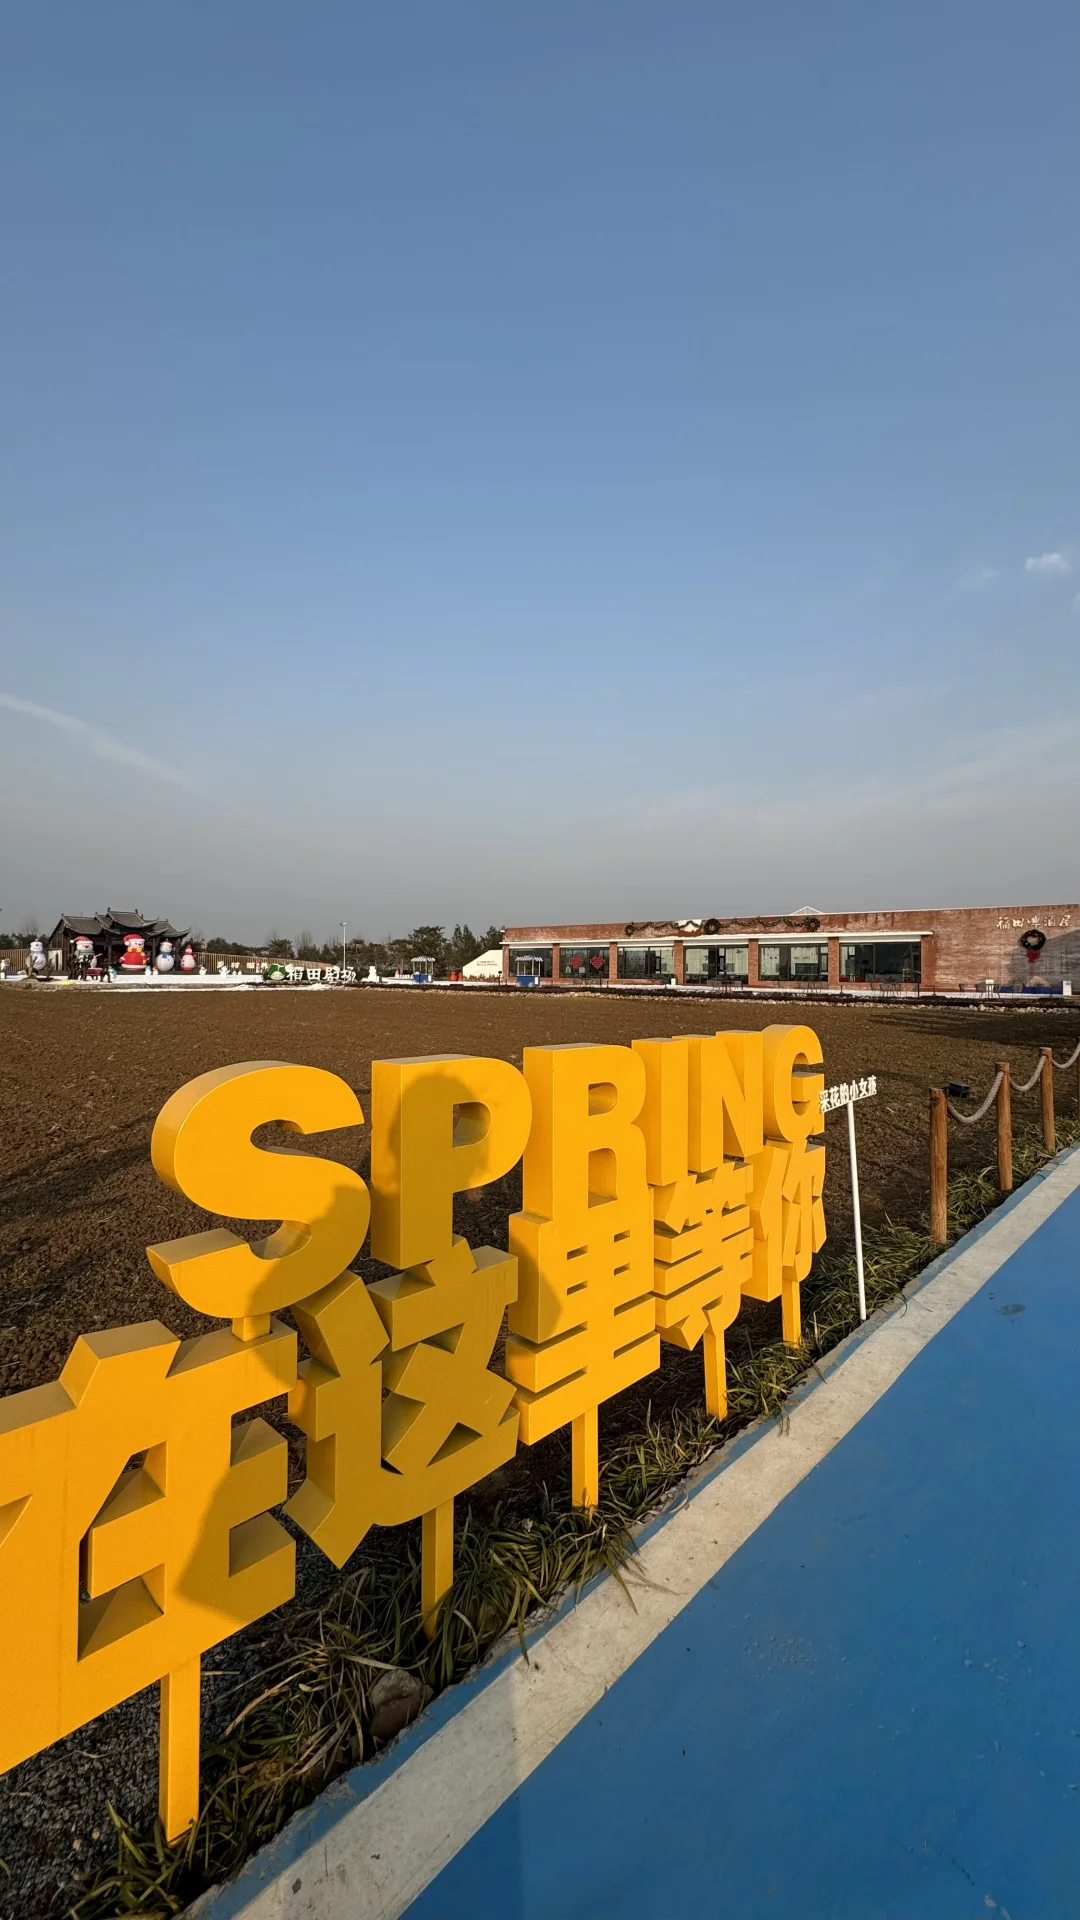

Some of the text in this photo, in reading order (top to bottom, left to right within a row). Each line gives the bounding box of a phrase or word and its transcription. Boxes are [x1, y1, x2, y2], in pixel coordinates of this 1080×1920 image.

[995, 914, 1072, 930] 稻田啤酒屋
[286, 965, 357, 984] 稻田剧场
[818, 1074, 877, 1113] 采花的小女孩
[147, 1025, 825, 1318] SPRING
[0, 1140, 827, 1774] 在这里等你
